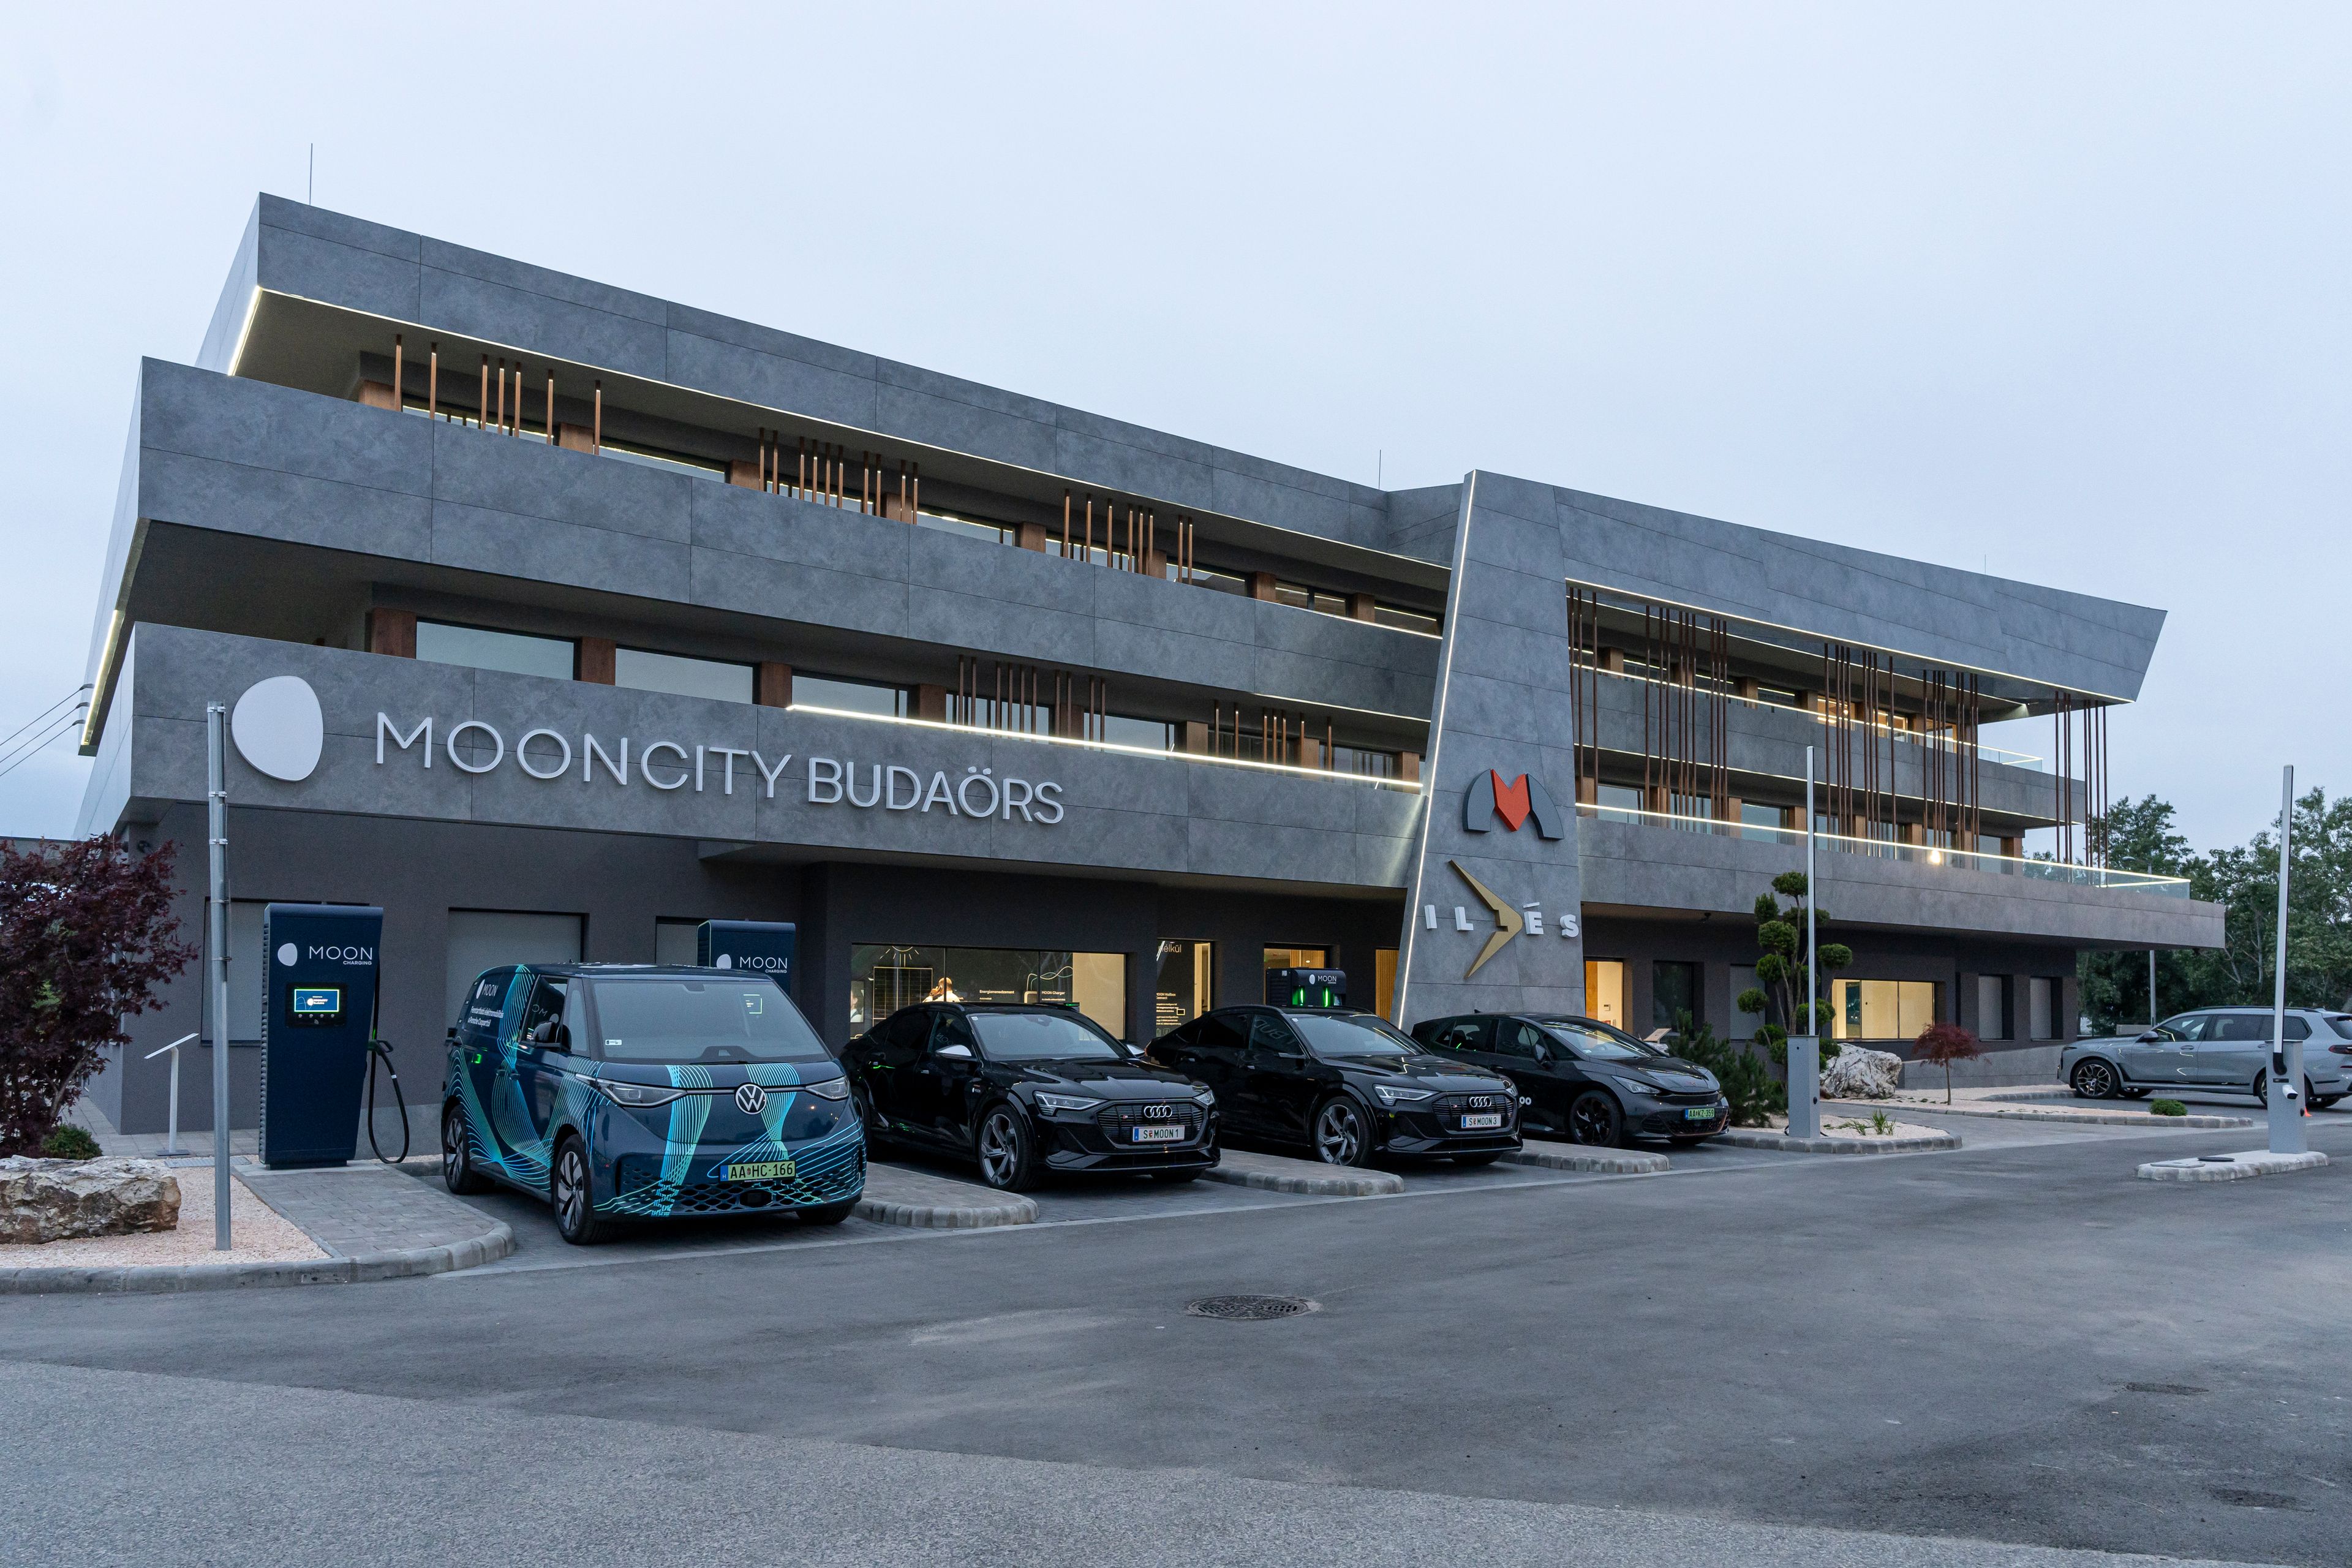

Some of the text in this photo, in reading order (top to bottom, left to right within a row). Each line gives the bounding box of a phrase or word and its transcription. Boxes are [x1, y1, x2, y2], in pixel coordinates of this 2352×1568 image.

[377, 712, 1064, 824] MOONCITY BUDAÖRS
[309, 946, 372, 960] MOON
[740, 956, 788, 969] MOON
[482, 984, 499, 997] MOON
[1477, 1117, 1493, 1126] MOON
[1153, 1129, 1174, 1139] MOON
[730, 1163, 793, 1179] AA HC-166
